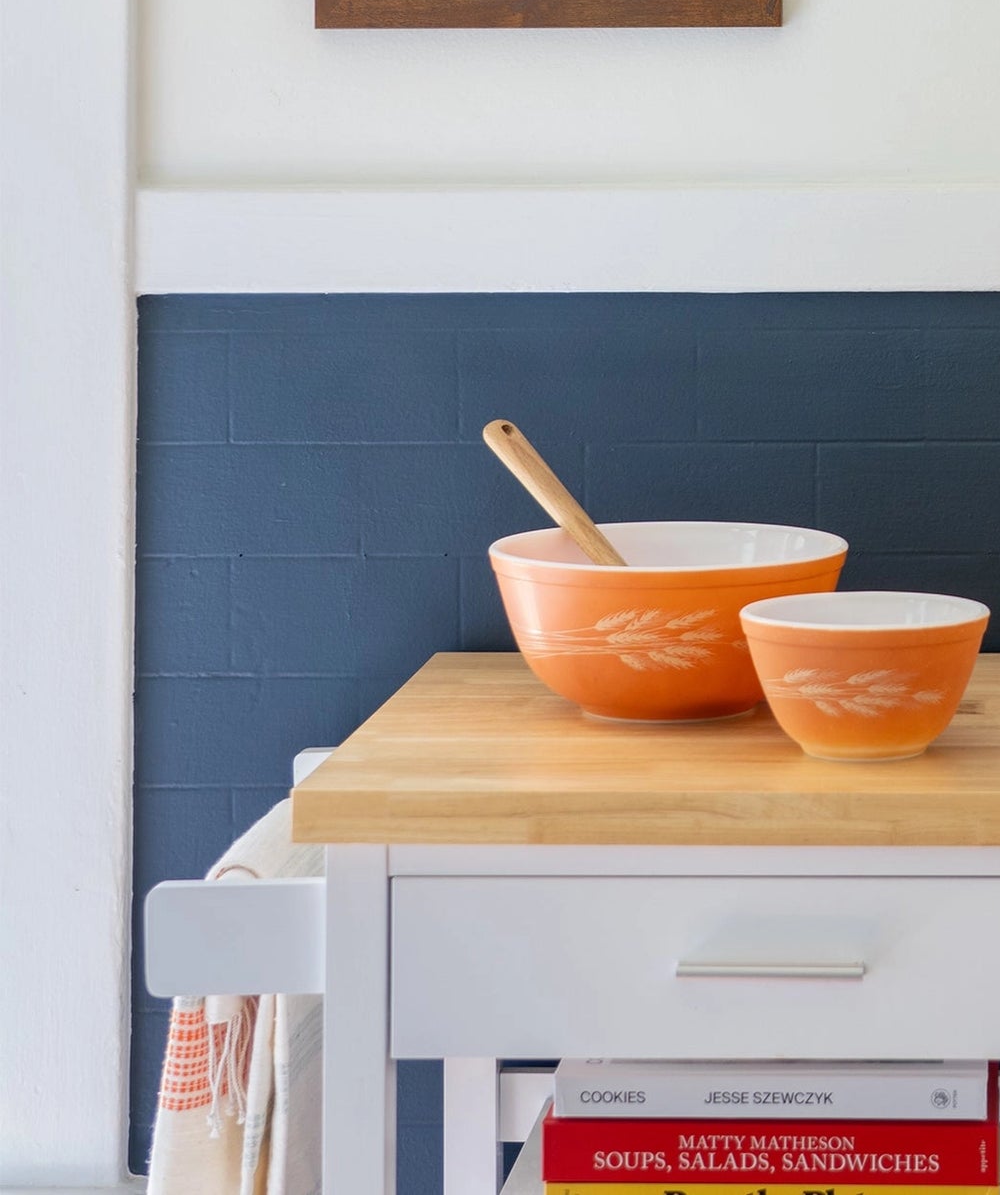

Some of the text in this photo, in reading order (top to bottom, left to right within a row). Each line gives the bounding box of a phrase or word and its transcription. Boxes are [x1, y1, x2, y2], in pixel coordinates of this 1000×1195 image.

[580, 1090, 646, 1104] COOKIES
[704, 1091, 833, 1105] JESSE SZEWCZYK
[678, 1135, 855, 1151] MATTY MATHESON
[593, 1151, 940, 1174] SOUPS, SALADS, SANDWICHES
